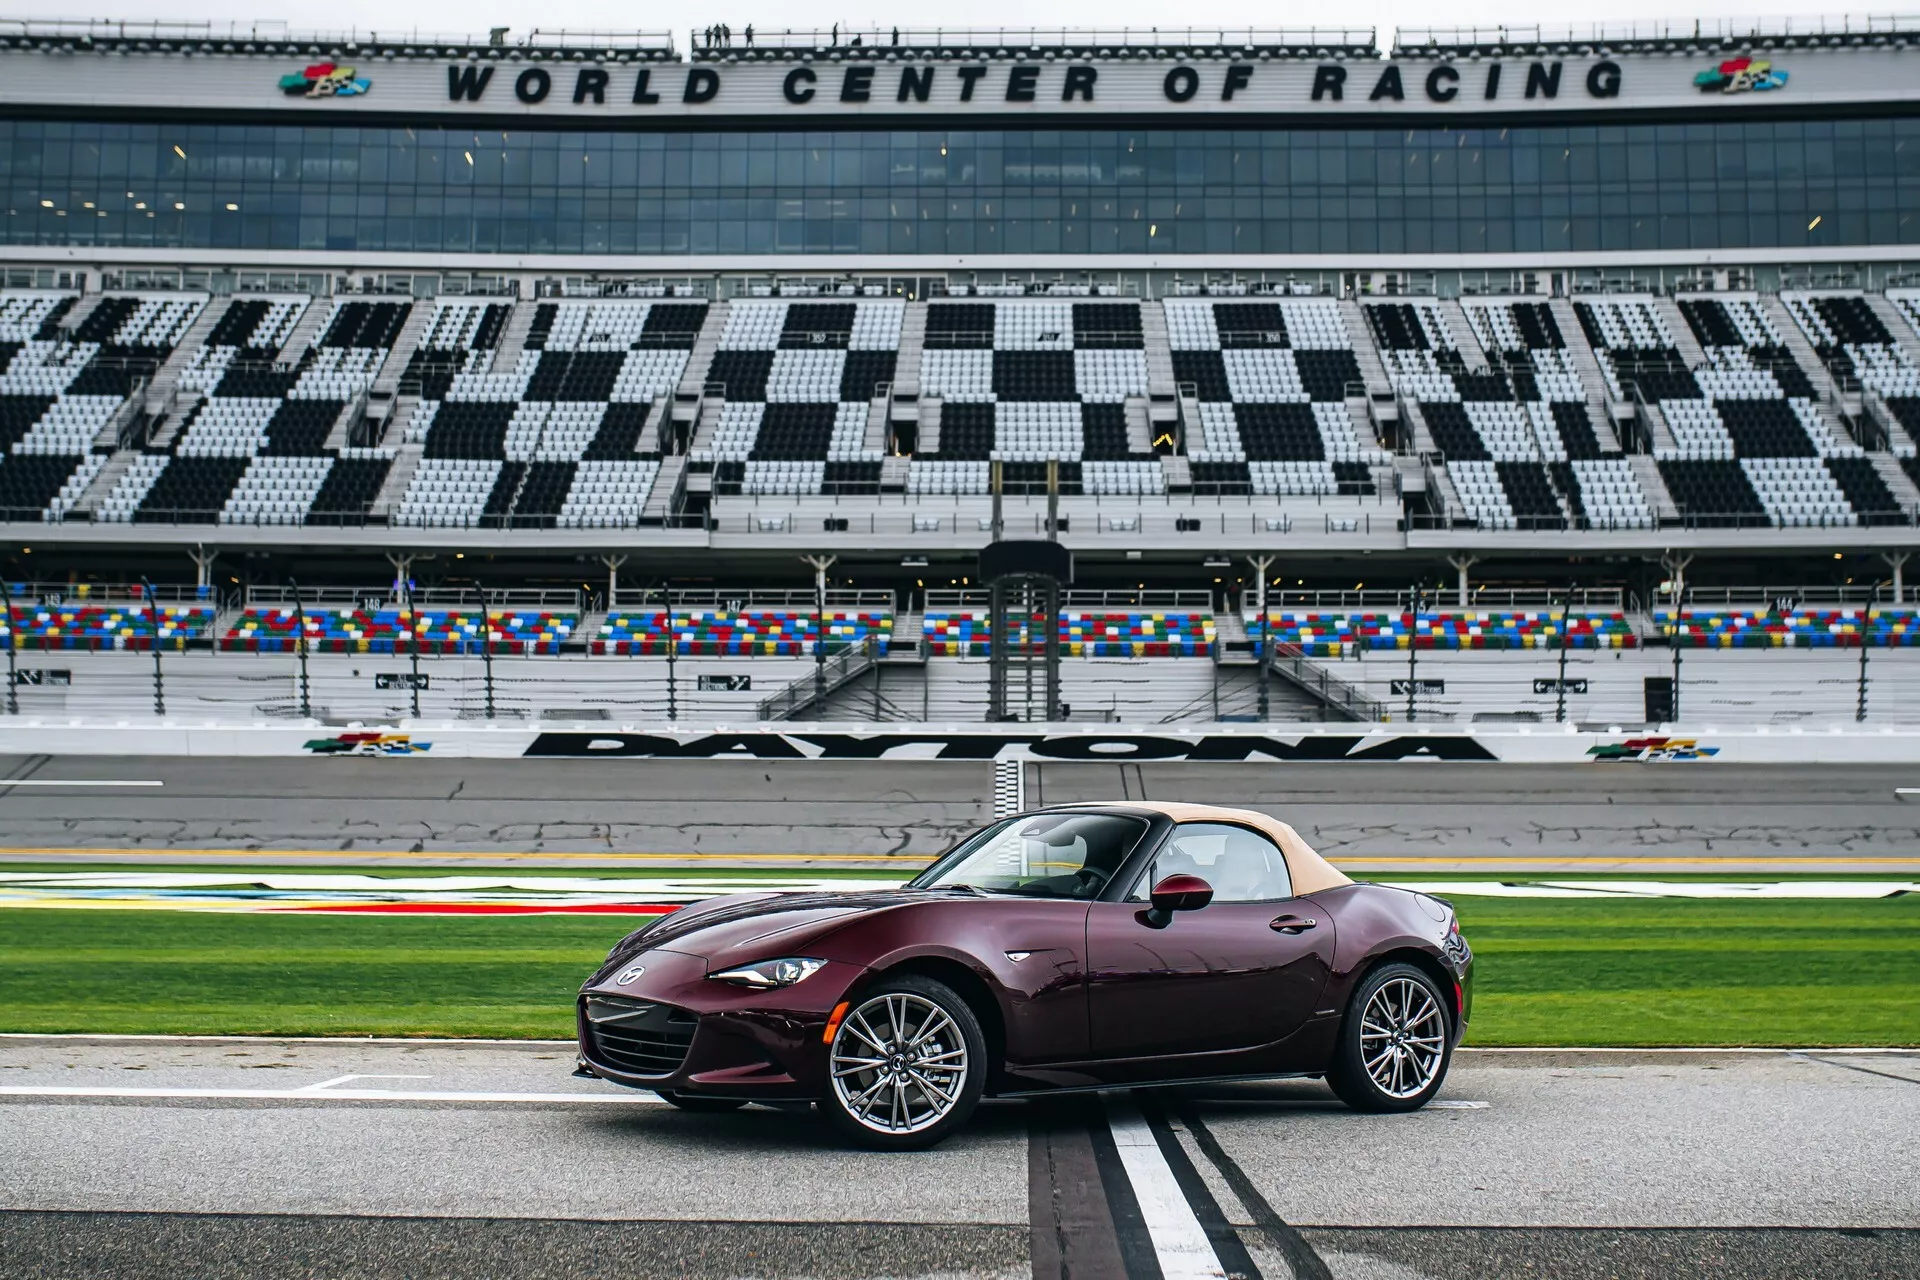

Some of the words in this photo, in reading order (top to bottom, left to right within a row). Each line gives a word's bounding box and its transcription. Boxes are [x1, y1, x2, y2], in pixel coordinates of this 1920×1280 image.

[447, 65, 720, 104] WORLD
[782, 65, 1098, 104] CENTER
[1163, 65, 1254, 102] OF
[1311, 60, 1623, 102] RACING
[364, 597, 380, 611] 148
[726, 599, 742, 613] 147
[1410, 600, 1426, 614] 15
[1776, 596, 1793, 612] 144
[522, 731, 1499, 761] DAYTONA
